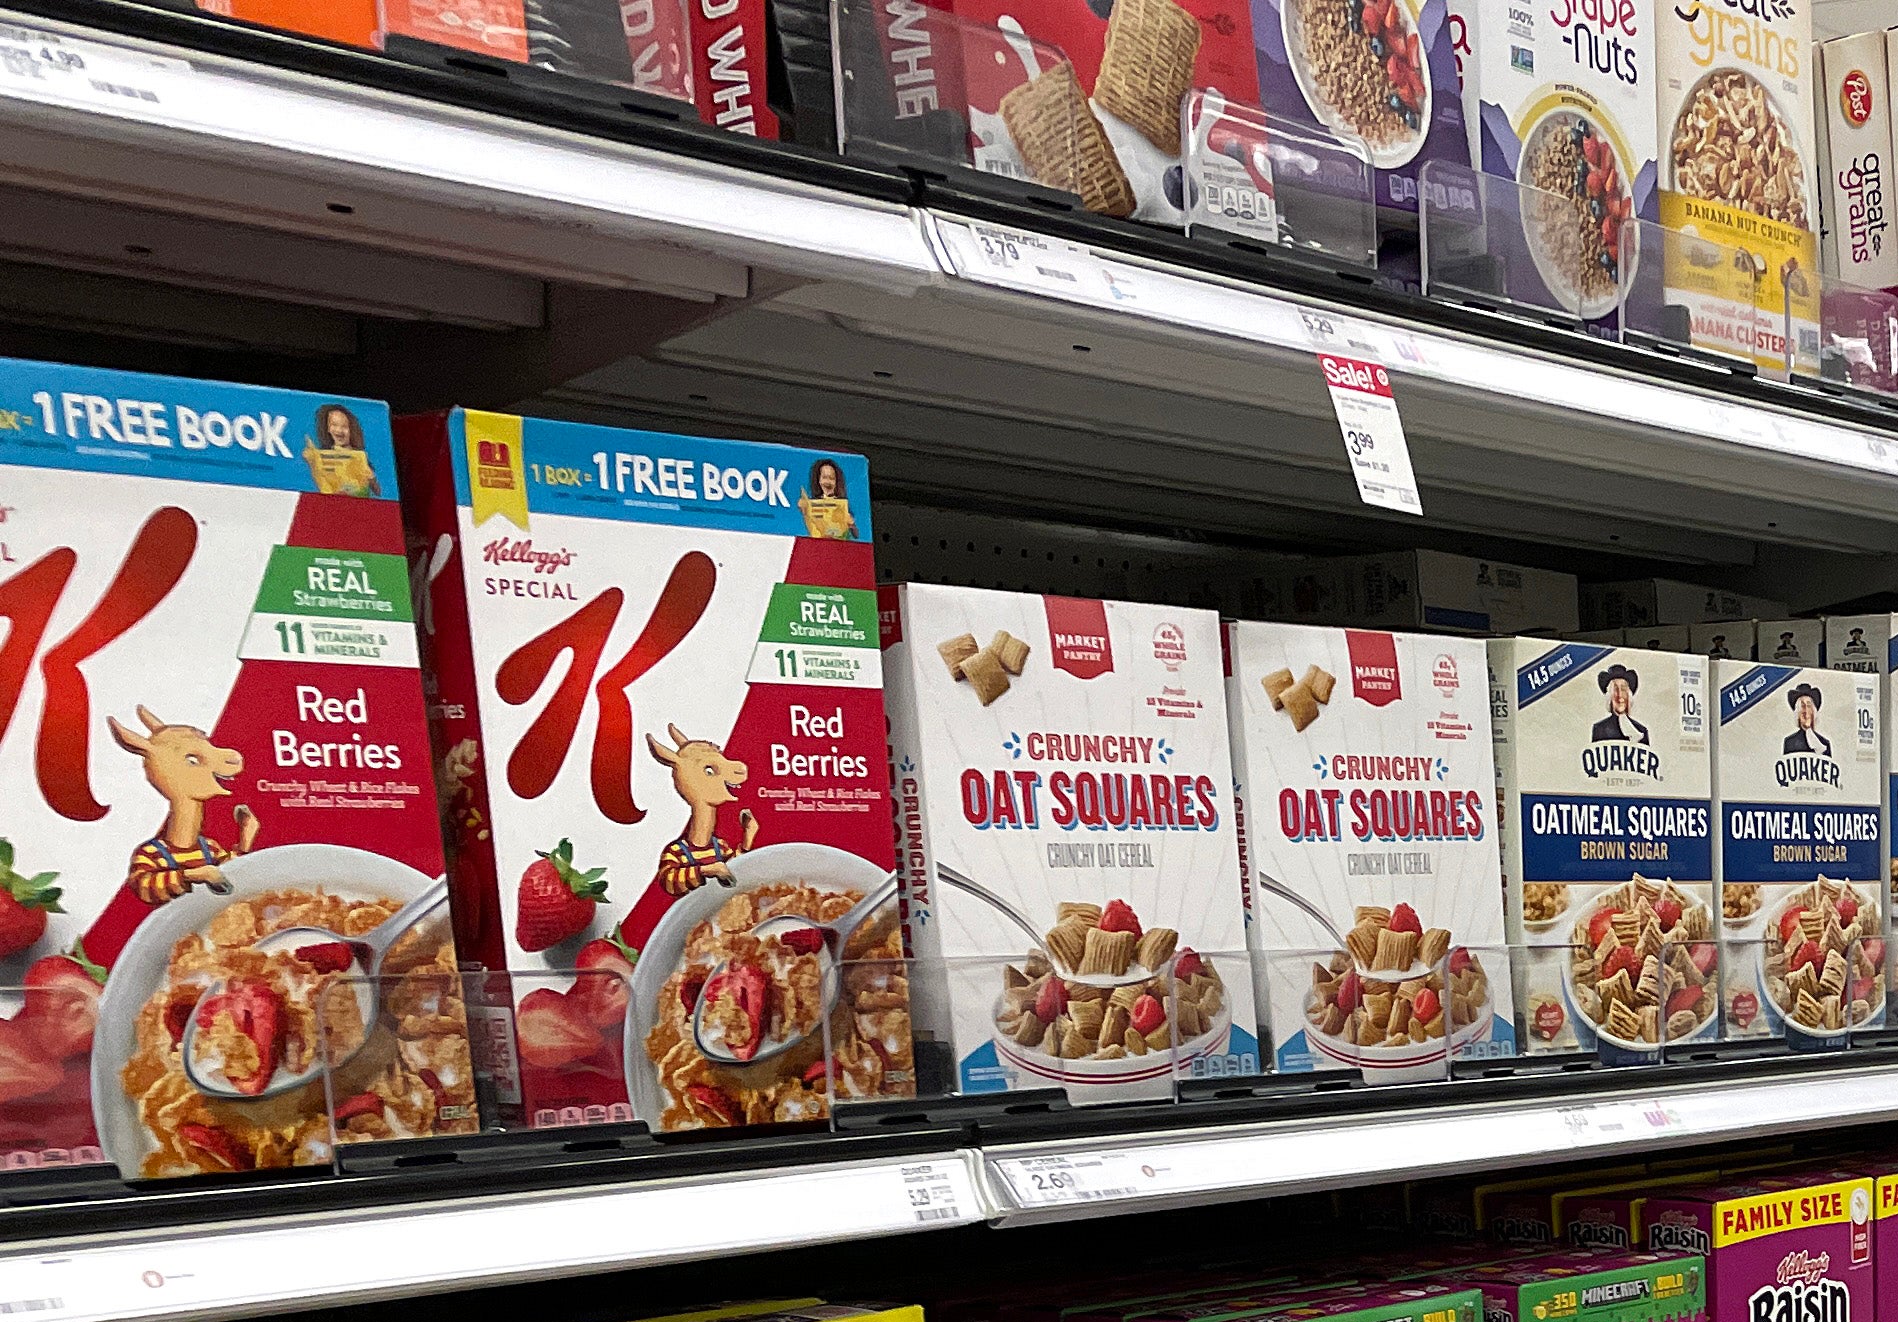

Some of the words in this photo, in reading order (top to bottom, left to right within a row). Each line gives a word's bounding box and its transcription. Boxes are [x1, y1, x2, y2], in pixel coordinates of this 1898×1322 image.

[1690, 12, 1800, 78] grains
[1685, 202, 1730, 227] BANANA
[1733, 212, 1757, 230] NUT
[1760, 220, 1802, 247] CRUNCH
[1322, 357, 1375, 391] Sale!
[33, 392, 57, 434] 1
[64, 393, 178, 449] FREE
[180, 399, 294, 460] BOOK
[546, 469, 580, 487] BOX
[593, 453, 610, 489] 1
[615, 456, 697, 500] FREE
[703, 467, 790, 507] BOOK
[483, 537, 577, 574] Kellogg's
[308, 566, 377, 595] REAL
[485, 578, 578, 600] SPECIAL
[294, 590, 393, 613] Strawberries
[801, 602, 854, 625] REAL
[275, 621, 305, 654] 11
[1056, 632, 1106, 652] MARKET
[1063, 650, 1100, 662] PANTRY
[496, 551, 716, 824] K
[1526, 665, 1554, 691] 14.5
[296, 686, 366, 724] Red
[273, 732, 401, 770] Berries
[1028, 732, 1153, 764] CRUNCHY
[1582, 743, 1660, 780] QUAKER
[960, 768, 1041, 831] OAT
[1051, 770, 1219, 832] SQUARES
[1532, 803, 1621, 836] OATMEAL
[1628, 801, 1708, 837] SQUARES
[1732, 812, 1809, 841] OATMEAL
[1814, 811, 1878, 841] SQUARES
[900, 778, 929, 904] CRUNCHY
[1047, 842, 1094, 868] CRUNCHY
[1098, 844, 1116, 867] OAT
[1118, 844, 1154, 868] CEREAL
[1581, 842, 1625, 860] BROWN
[1629, 842, 1668, 861] SUGAR
[1031, 1172, 1073, 1191] 2.69
[1722, 1205, 1793, 1235] FAMILY
[1799, 1196, 1842, 1221] SIZE
